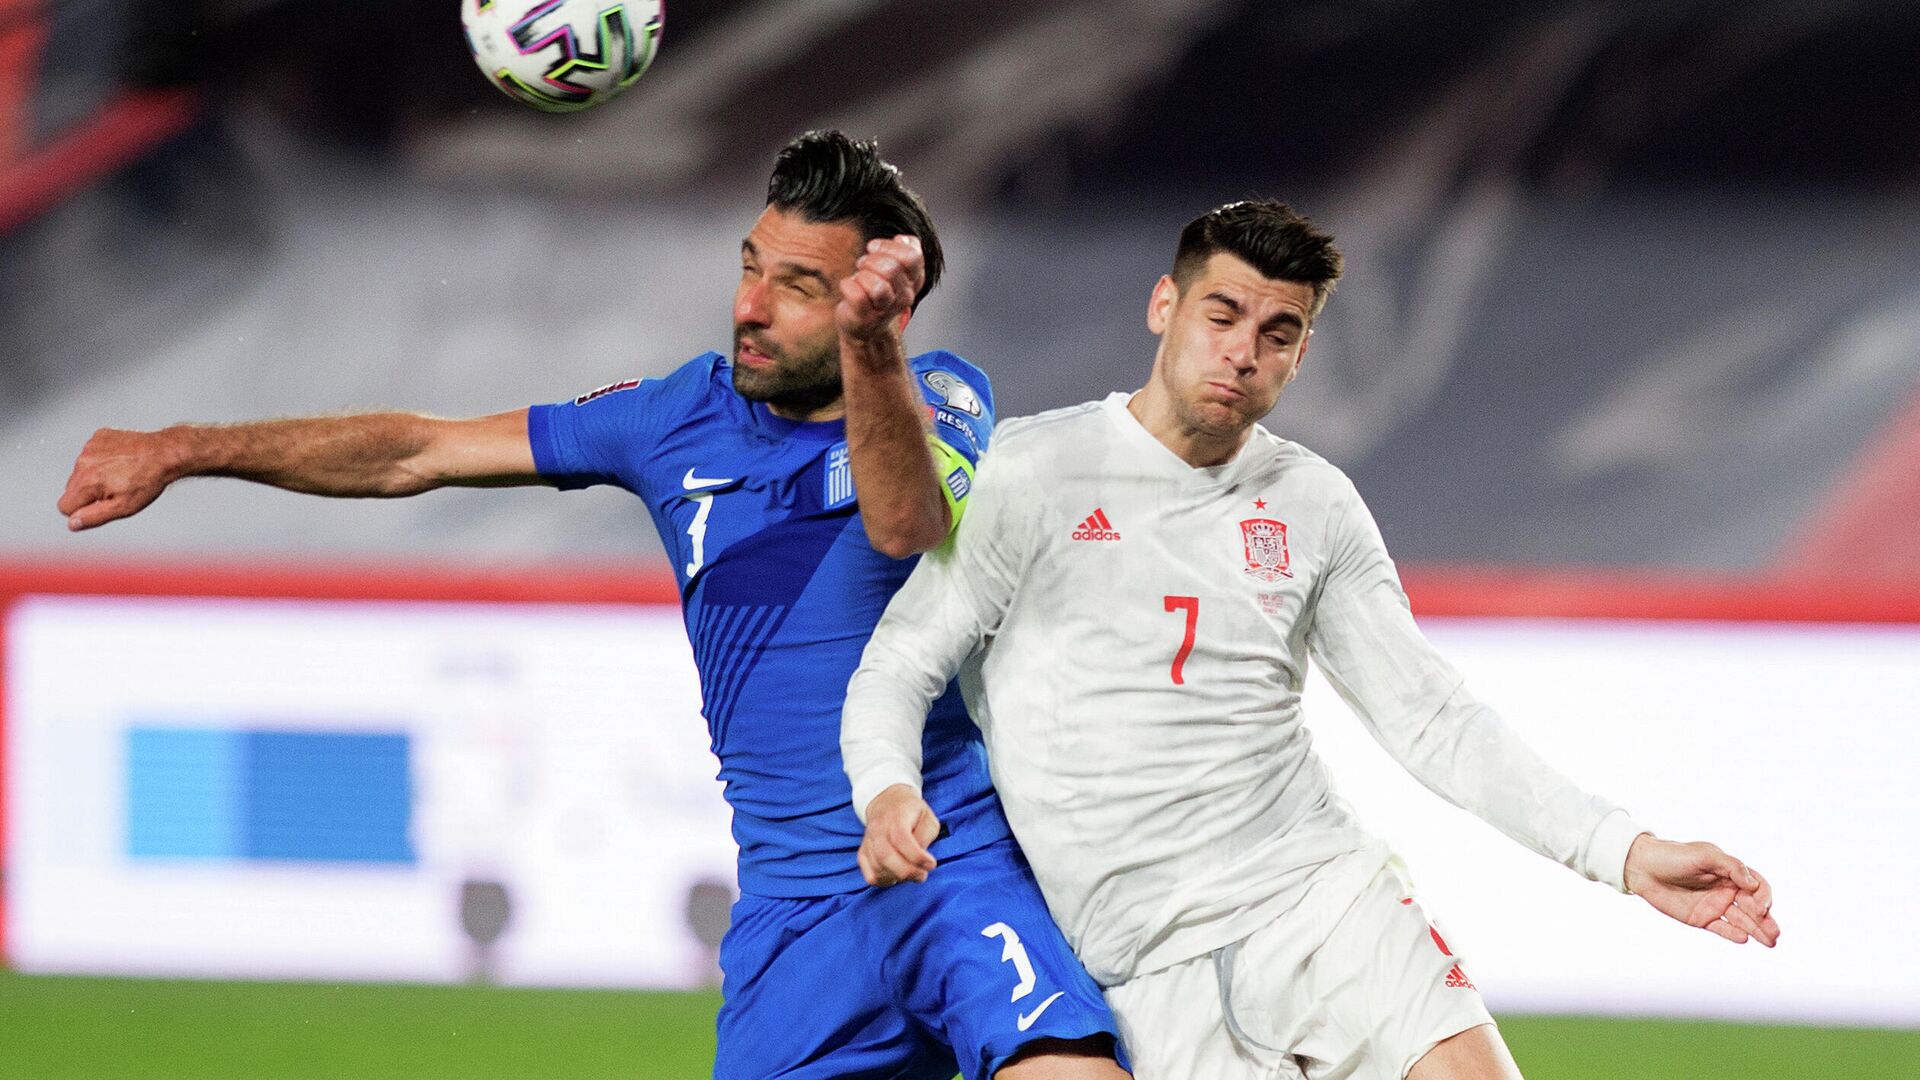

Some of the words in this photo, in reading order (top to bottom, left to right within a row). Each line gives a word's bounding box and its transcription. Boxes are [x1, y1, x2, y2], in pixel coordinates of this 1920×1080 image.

[686, 492, 714, 578] 3
[1071, 528, 1121, 541] adidas
[1164, 595, 1199, 685] 7
[981, 922, 1036, 1003] 3
[1445, 978, 1478, 992] adid
